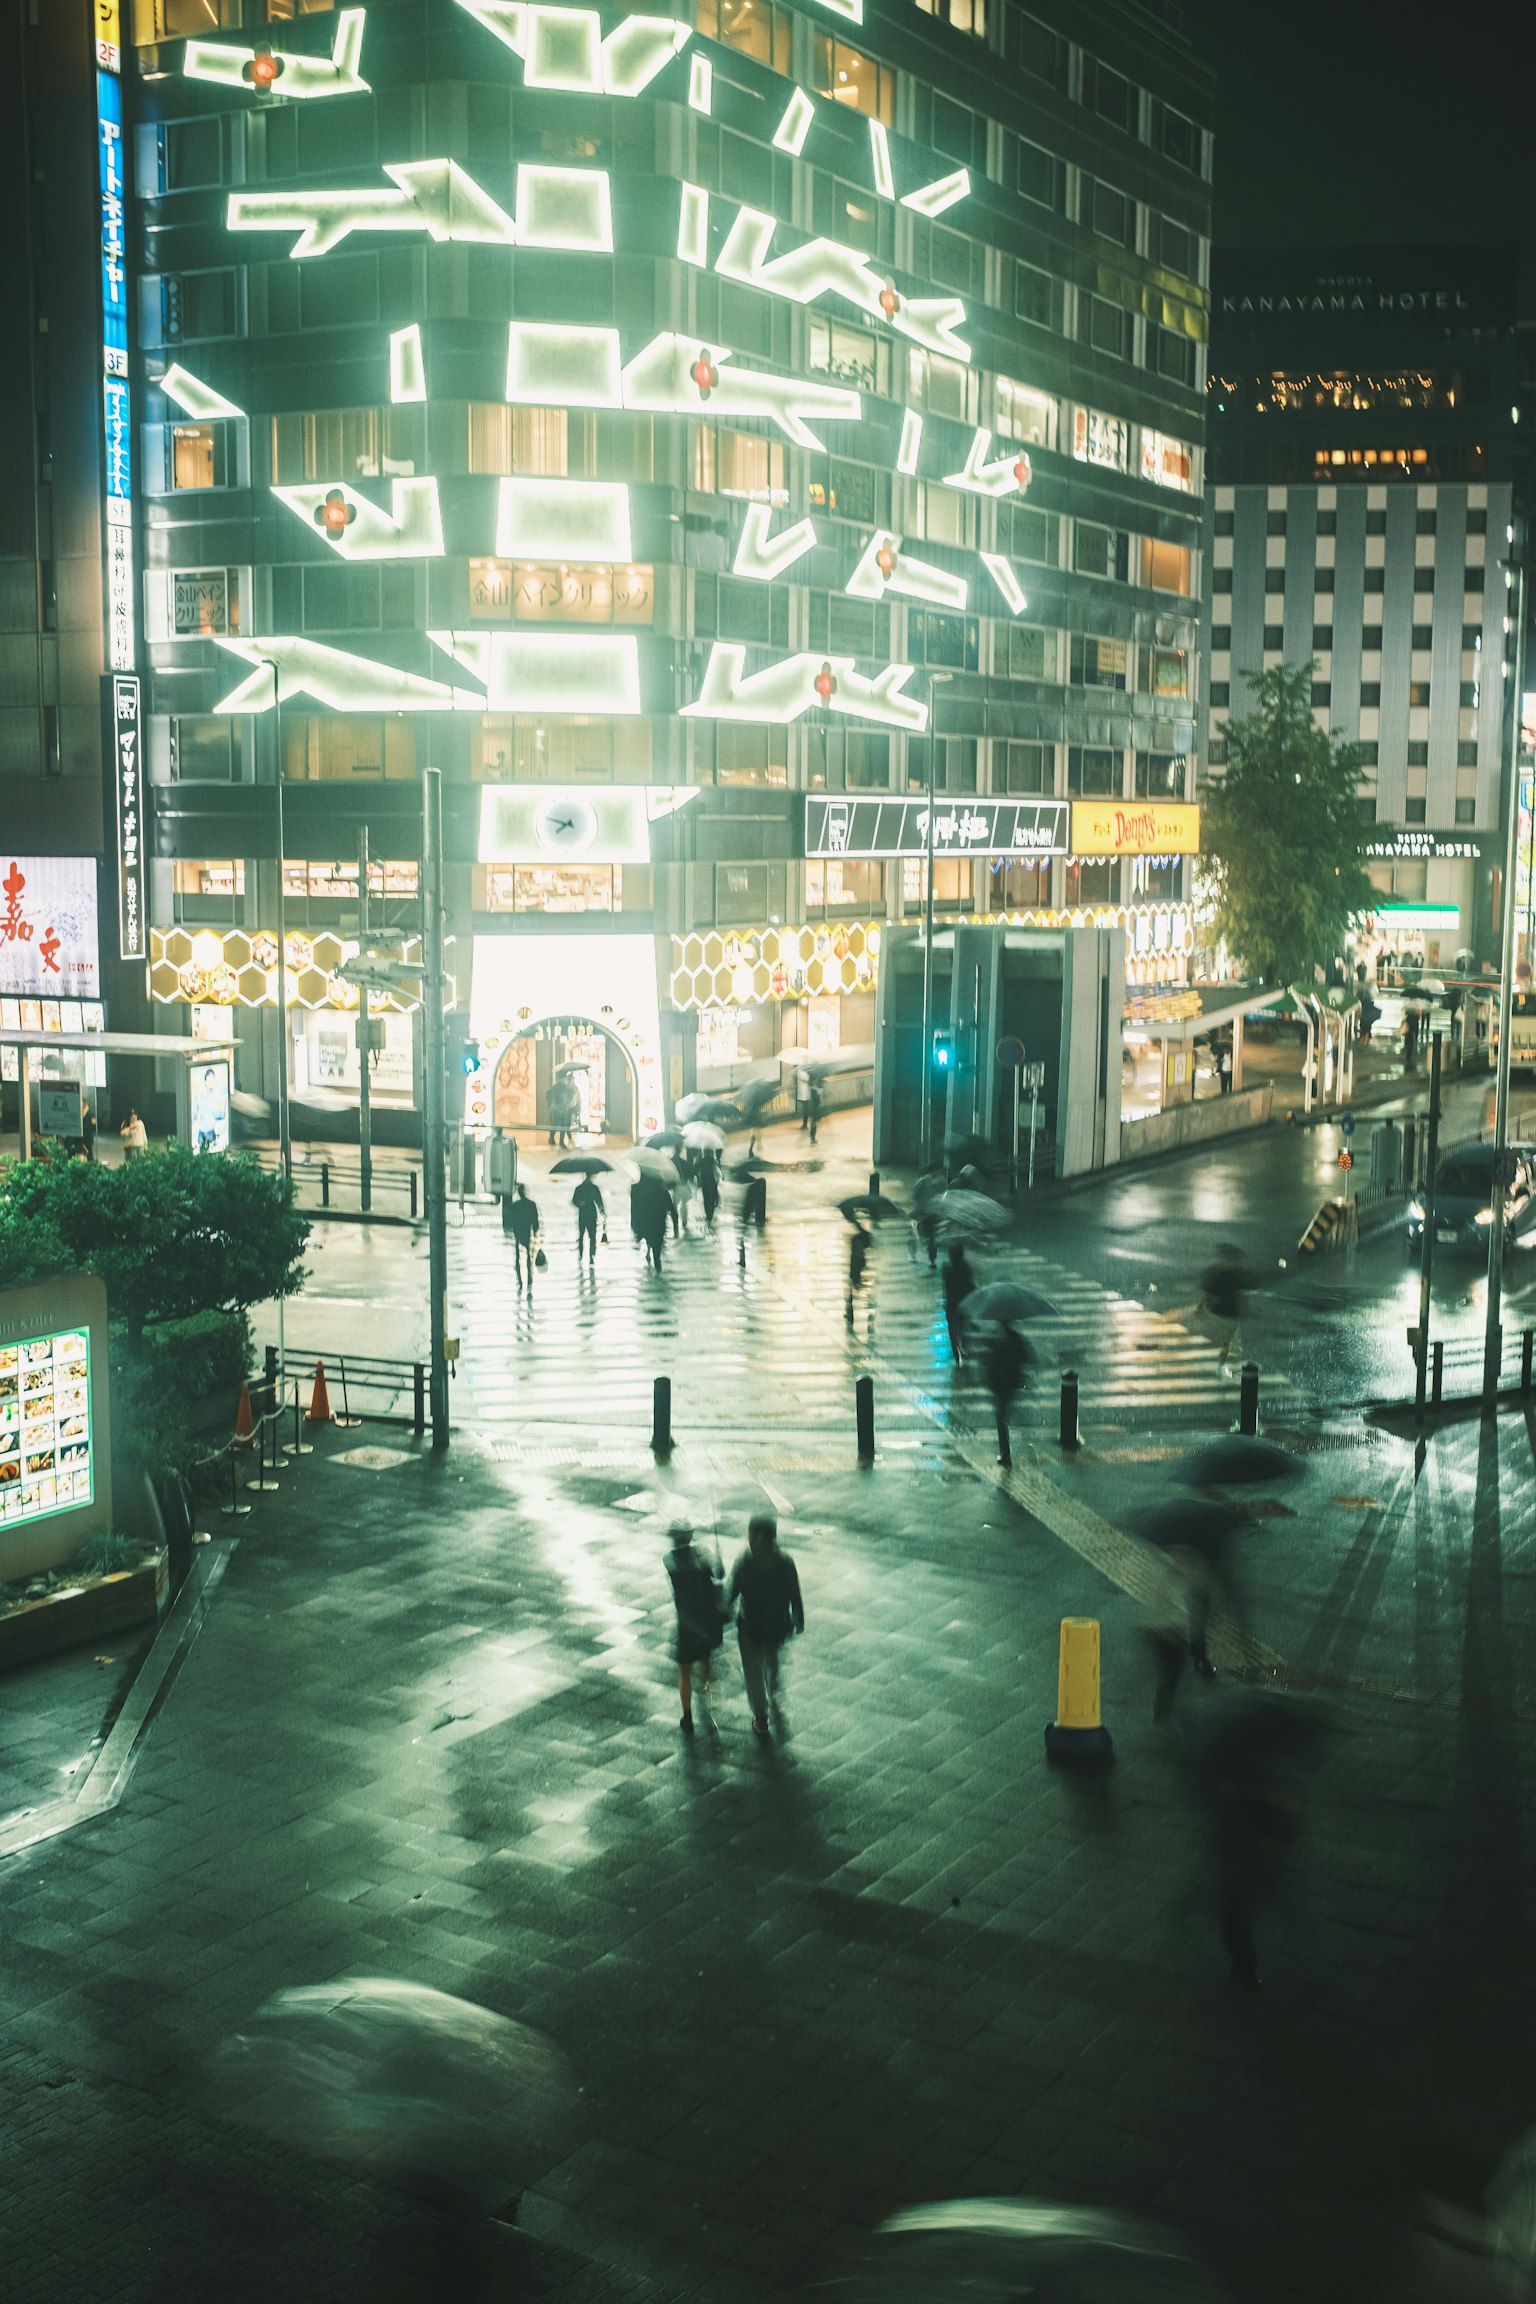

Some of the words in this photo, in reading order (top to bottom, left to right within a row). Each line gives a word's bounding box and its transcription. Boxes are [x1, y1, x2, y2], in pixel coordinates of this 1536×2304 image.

[99, 43, 116, 63] 2F
[99, 118, 124, 304] アートネイチャー
[1222, 293, 1366, 313] KANAYAMA
[1379, 291, 1469, 312] HOTEL
[106, 353, 125, 371] 3F
[176, 583, 226, 603] 金山ペイン
[1114, 808, 1156, 850] Denny's
[1435, 843, 1481, 858] HOTEL
[319, 1066, 345, 1077] LAB
